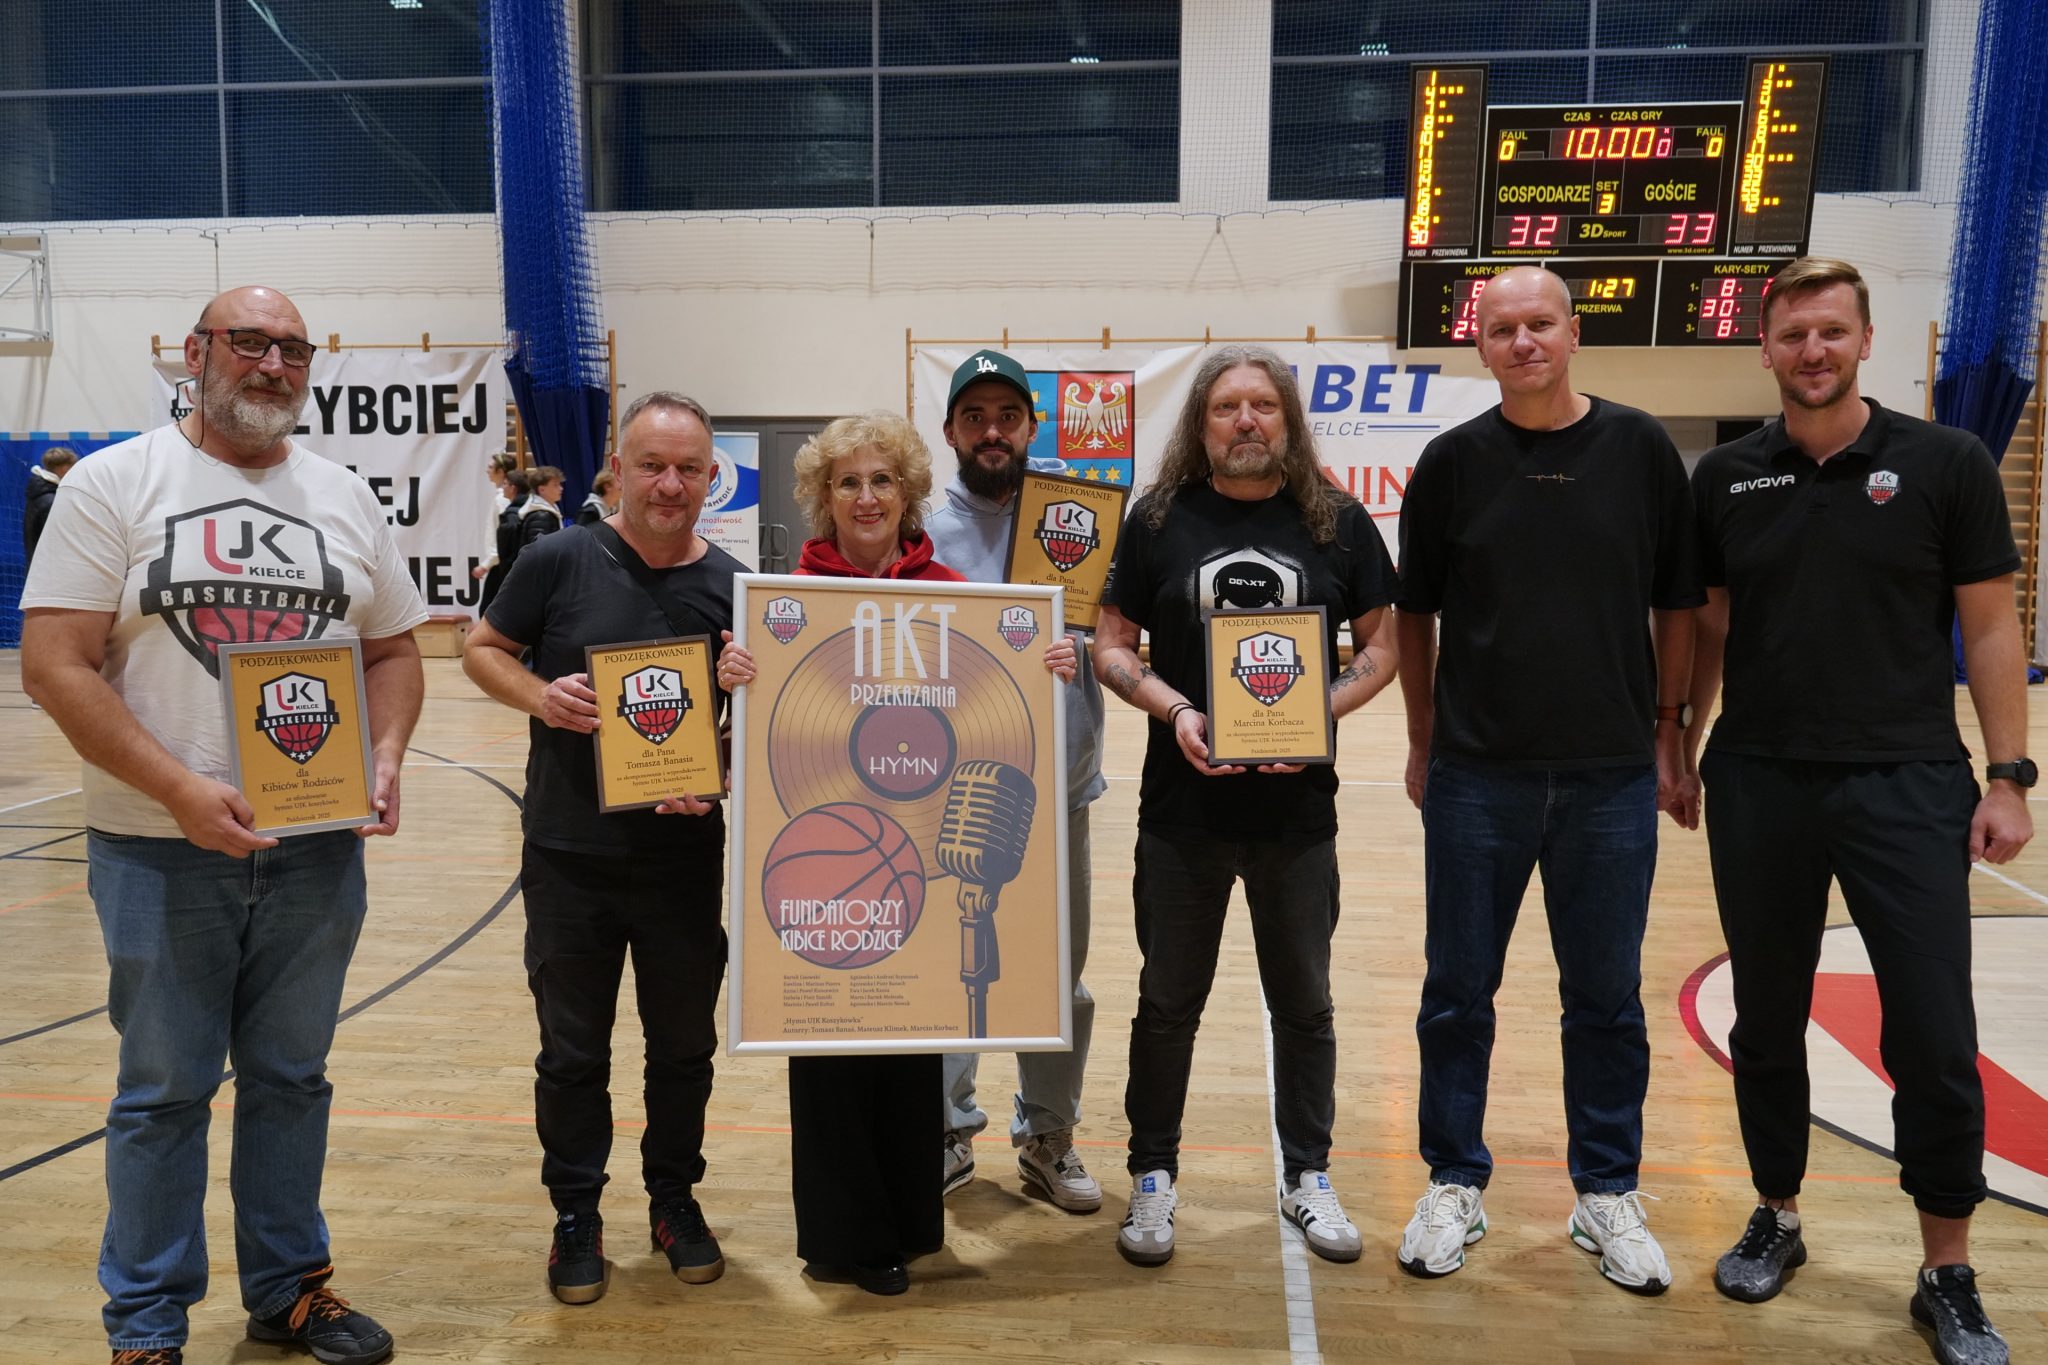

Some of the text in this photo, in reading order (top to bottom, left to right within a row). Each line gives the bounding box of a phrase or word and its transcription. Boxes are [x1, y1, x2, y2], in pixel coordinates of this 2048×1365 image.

[1563, 110, 1663, 122] CZAS CZAS GRY
[1501, 131, 1528, 140] FAUL
[1696, 128, 1724, 137] FAUL
[1499, 140, 1515, 160] 0
[1706, 137, 1723, 158] 0
[1498, 184, 1592, 204] GOSPODARZE
[1596, 181, 1619, 191] SET
[1644, 179, 1697, 202] GOŚCIE
[1598, 193, 1614, 214] 3
[1508, 215, 1558, 246] 32
[1664, 214, 1715, 244] 33
[1408, 248, 1468, 257] NUMER PRZEWINIENIA
[1733, 244, 1797, 254] NUMER PRZEWINIENIA
[1714, 264, 1770, 274] KARY-SETY
[1589, 278, 1634, 298] 1:27
[1575, 304, 1623, 313] PRZERWA
[975, 356, 998, 373] LA
[1288, 364, 1442, 413] BET
[1310, 422, 1367, 436] ELCE
[1034, 480, 1113, 502] PODZIĘKOWANIE
[1730, 474, 1796, 494] GIVOVA
[1040, 531, 1097, 547] BASKETBALL
[248, 565, 306, 580] KIELCE
[1046, 574, 1057, 582] dla
[1059, 574, 1075, 584] Pana
[1064, 585, 1089, 596] Klimka
[159, 585, 340, 614] BASKETBALL
[1222, 616, 1310, 628] PODZIĘKOWANIE
[850, 600, 957, 679] AKT
[240, 652, 341, 668] PODZIĘKOWANIE
[604, 646, 695, 664] PODZIĘKOWANIE
[1237, 666, 1300, 675] BASKETBALL
[850, 683, 957, 708] PRZEKAZANIA
[624, 700, 689, 714] BASKETBALL
[1252, 709, 1285, 718] dla Pana
[263, 714, 335, 728] BASKETBALL
[1233, 718, 1304, 728] Marcina Korbacza
[642, 748, 676, 758] dla Pana
[625, 755, 693, 770] Tomasza Banasia
[869, 756, 938, 775] HYMN
[296, 768, 309, 778] dla
[262, 776, 345, 792] Kibiców Rodziców
[780, 899, 904, 925] FUNDATORZY
[780, 929, 903, 951] KIBICE RODZICE
